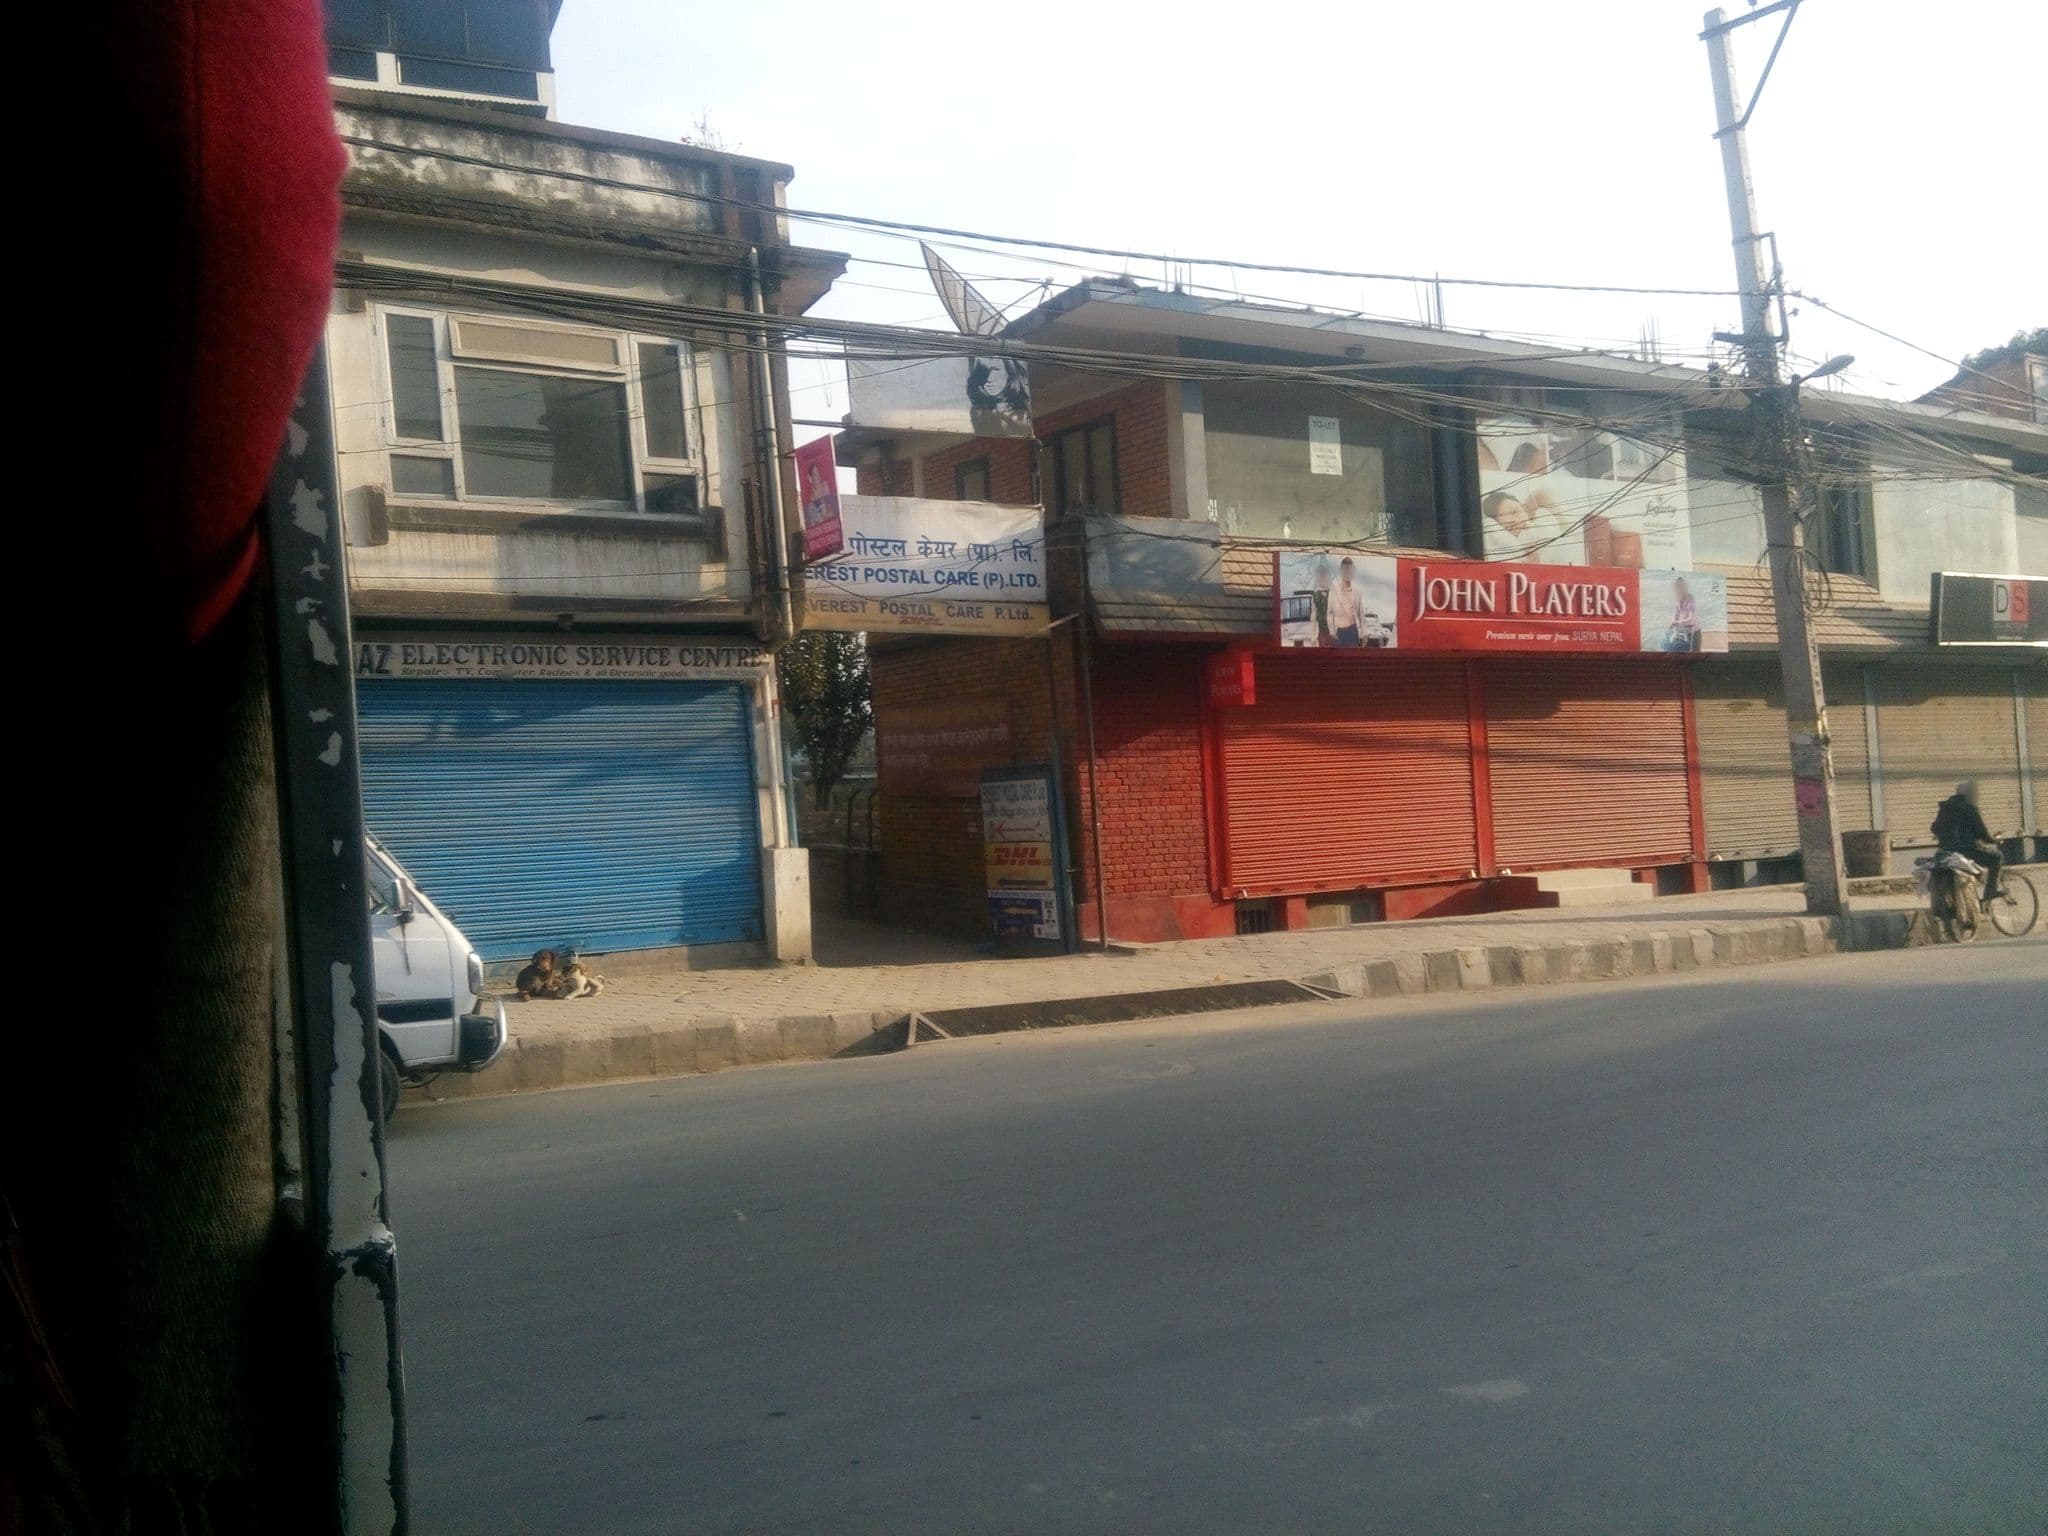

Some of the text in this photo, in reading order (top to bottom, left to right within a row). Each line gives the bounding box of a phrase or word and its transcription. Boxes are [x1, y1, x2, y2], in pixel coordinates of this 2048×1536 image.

[848, 531, 907, 557] पोस्टल
[916, 534, 957, 560] केयर
[864, 567, 930, 585] POSTAL
[934, 570, 979, 586] CARE
[1415, 566, 1627, 622] JOHN PLAYERS
[803, 599, 868, 614] VEREST
[880, 601, 936, 617] POSTAL
[946, 605, 984, 619] CARE
[1572, 631, 1597, 641] SURYA
[1600, 632, 1625, 643] NEPAL
[358, 643, 763, 675] AZ ELECTRONIC SERVICE CENTRE
[994, 847, 1042, 866] DHL
